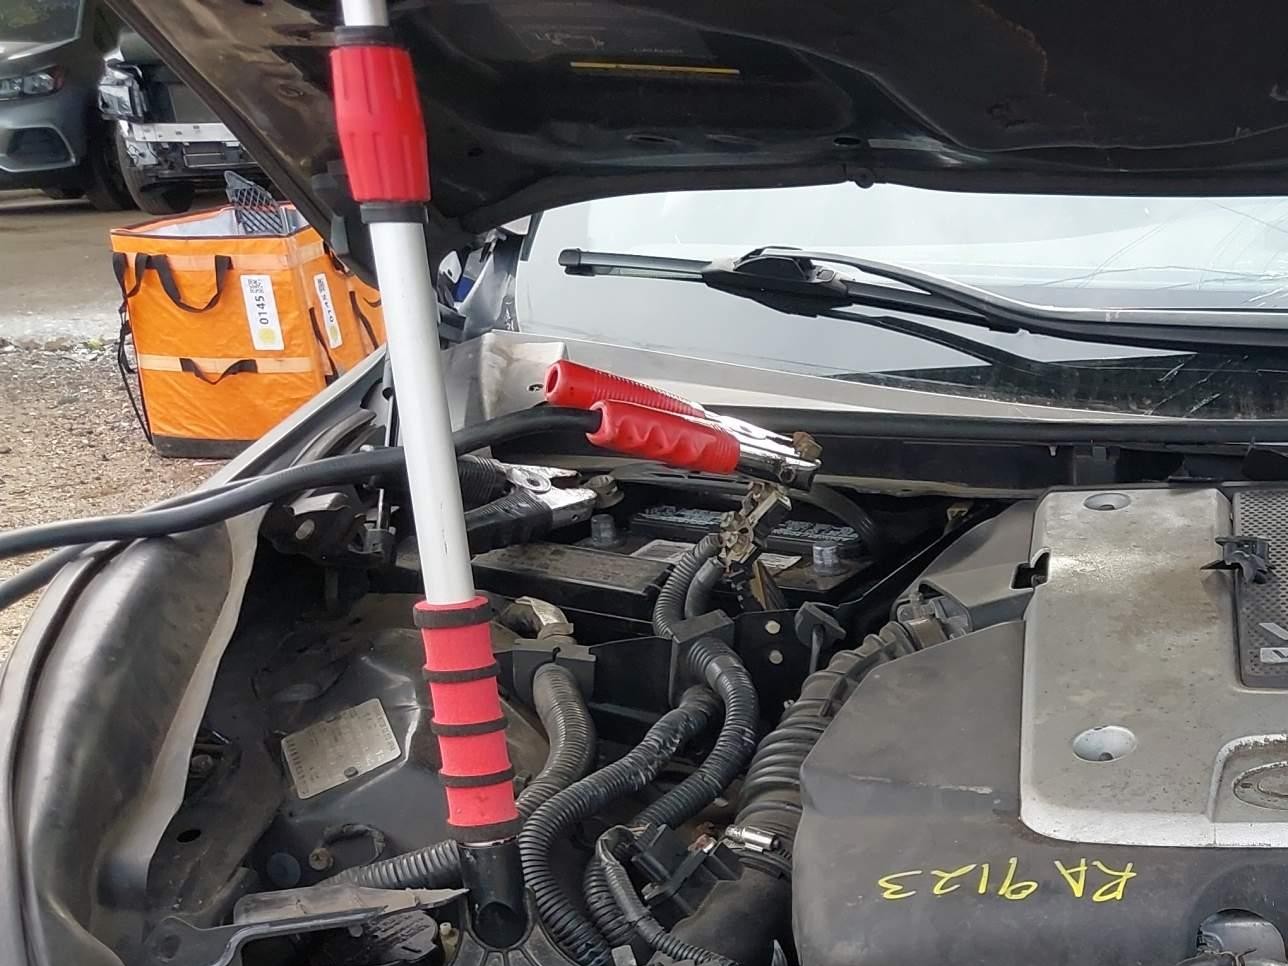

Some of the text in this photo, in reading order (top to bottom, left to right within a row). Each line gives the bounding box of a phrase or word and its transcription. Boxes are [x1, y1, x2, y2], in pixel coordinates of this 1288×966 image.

[254, 295, 269, 325] 0145
[877, 857, 1137, 903] RA 9123
